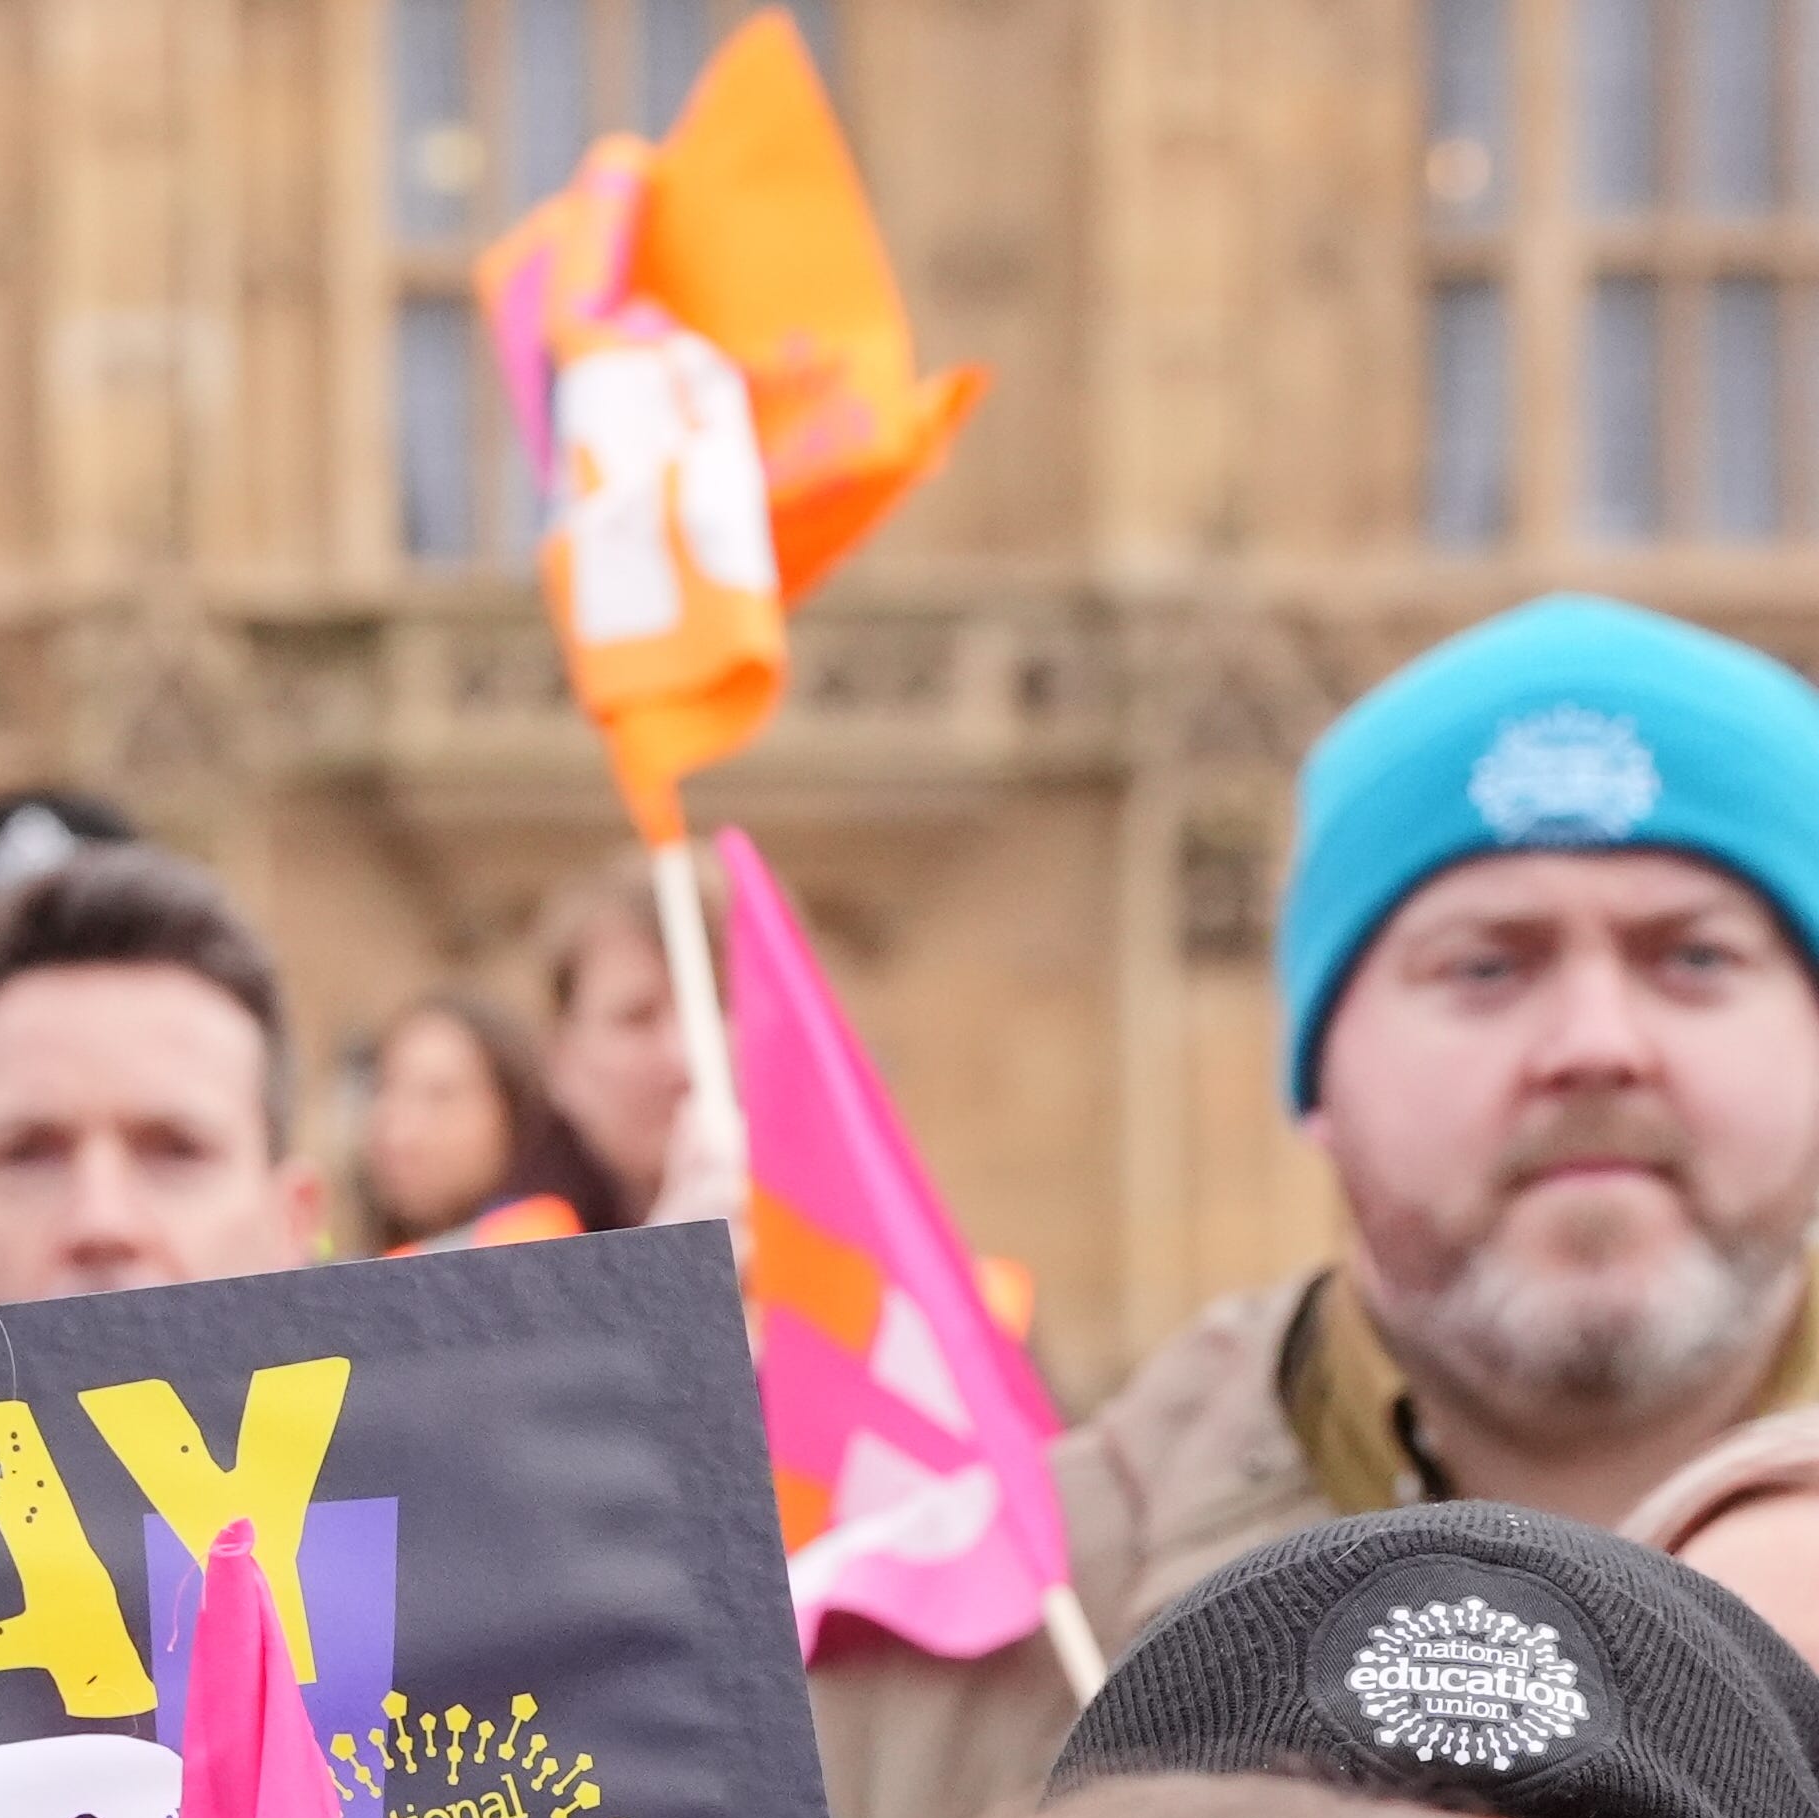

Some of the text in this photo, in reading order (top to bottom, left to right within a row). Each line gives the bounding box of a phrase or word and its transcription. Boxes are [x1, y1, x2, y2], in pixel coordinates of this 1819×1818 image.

[1413, 1639, 1529, 1670] national
[1350, 1656, 1587, 1718] education
[1424, 1695, 1510, 1720] union
